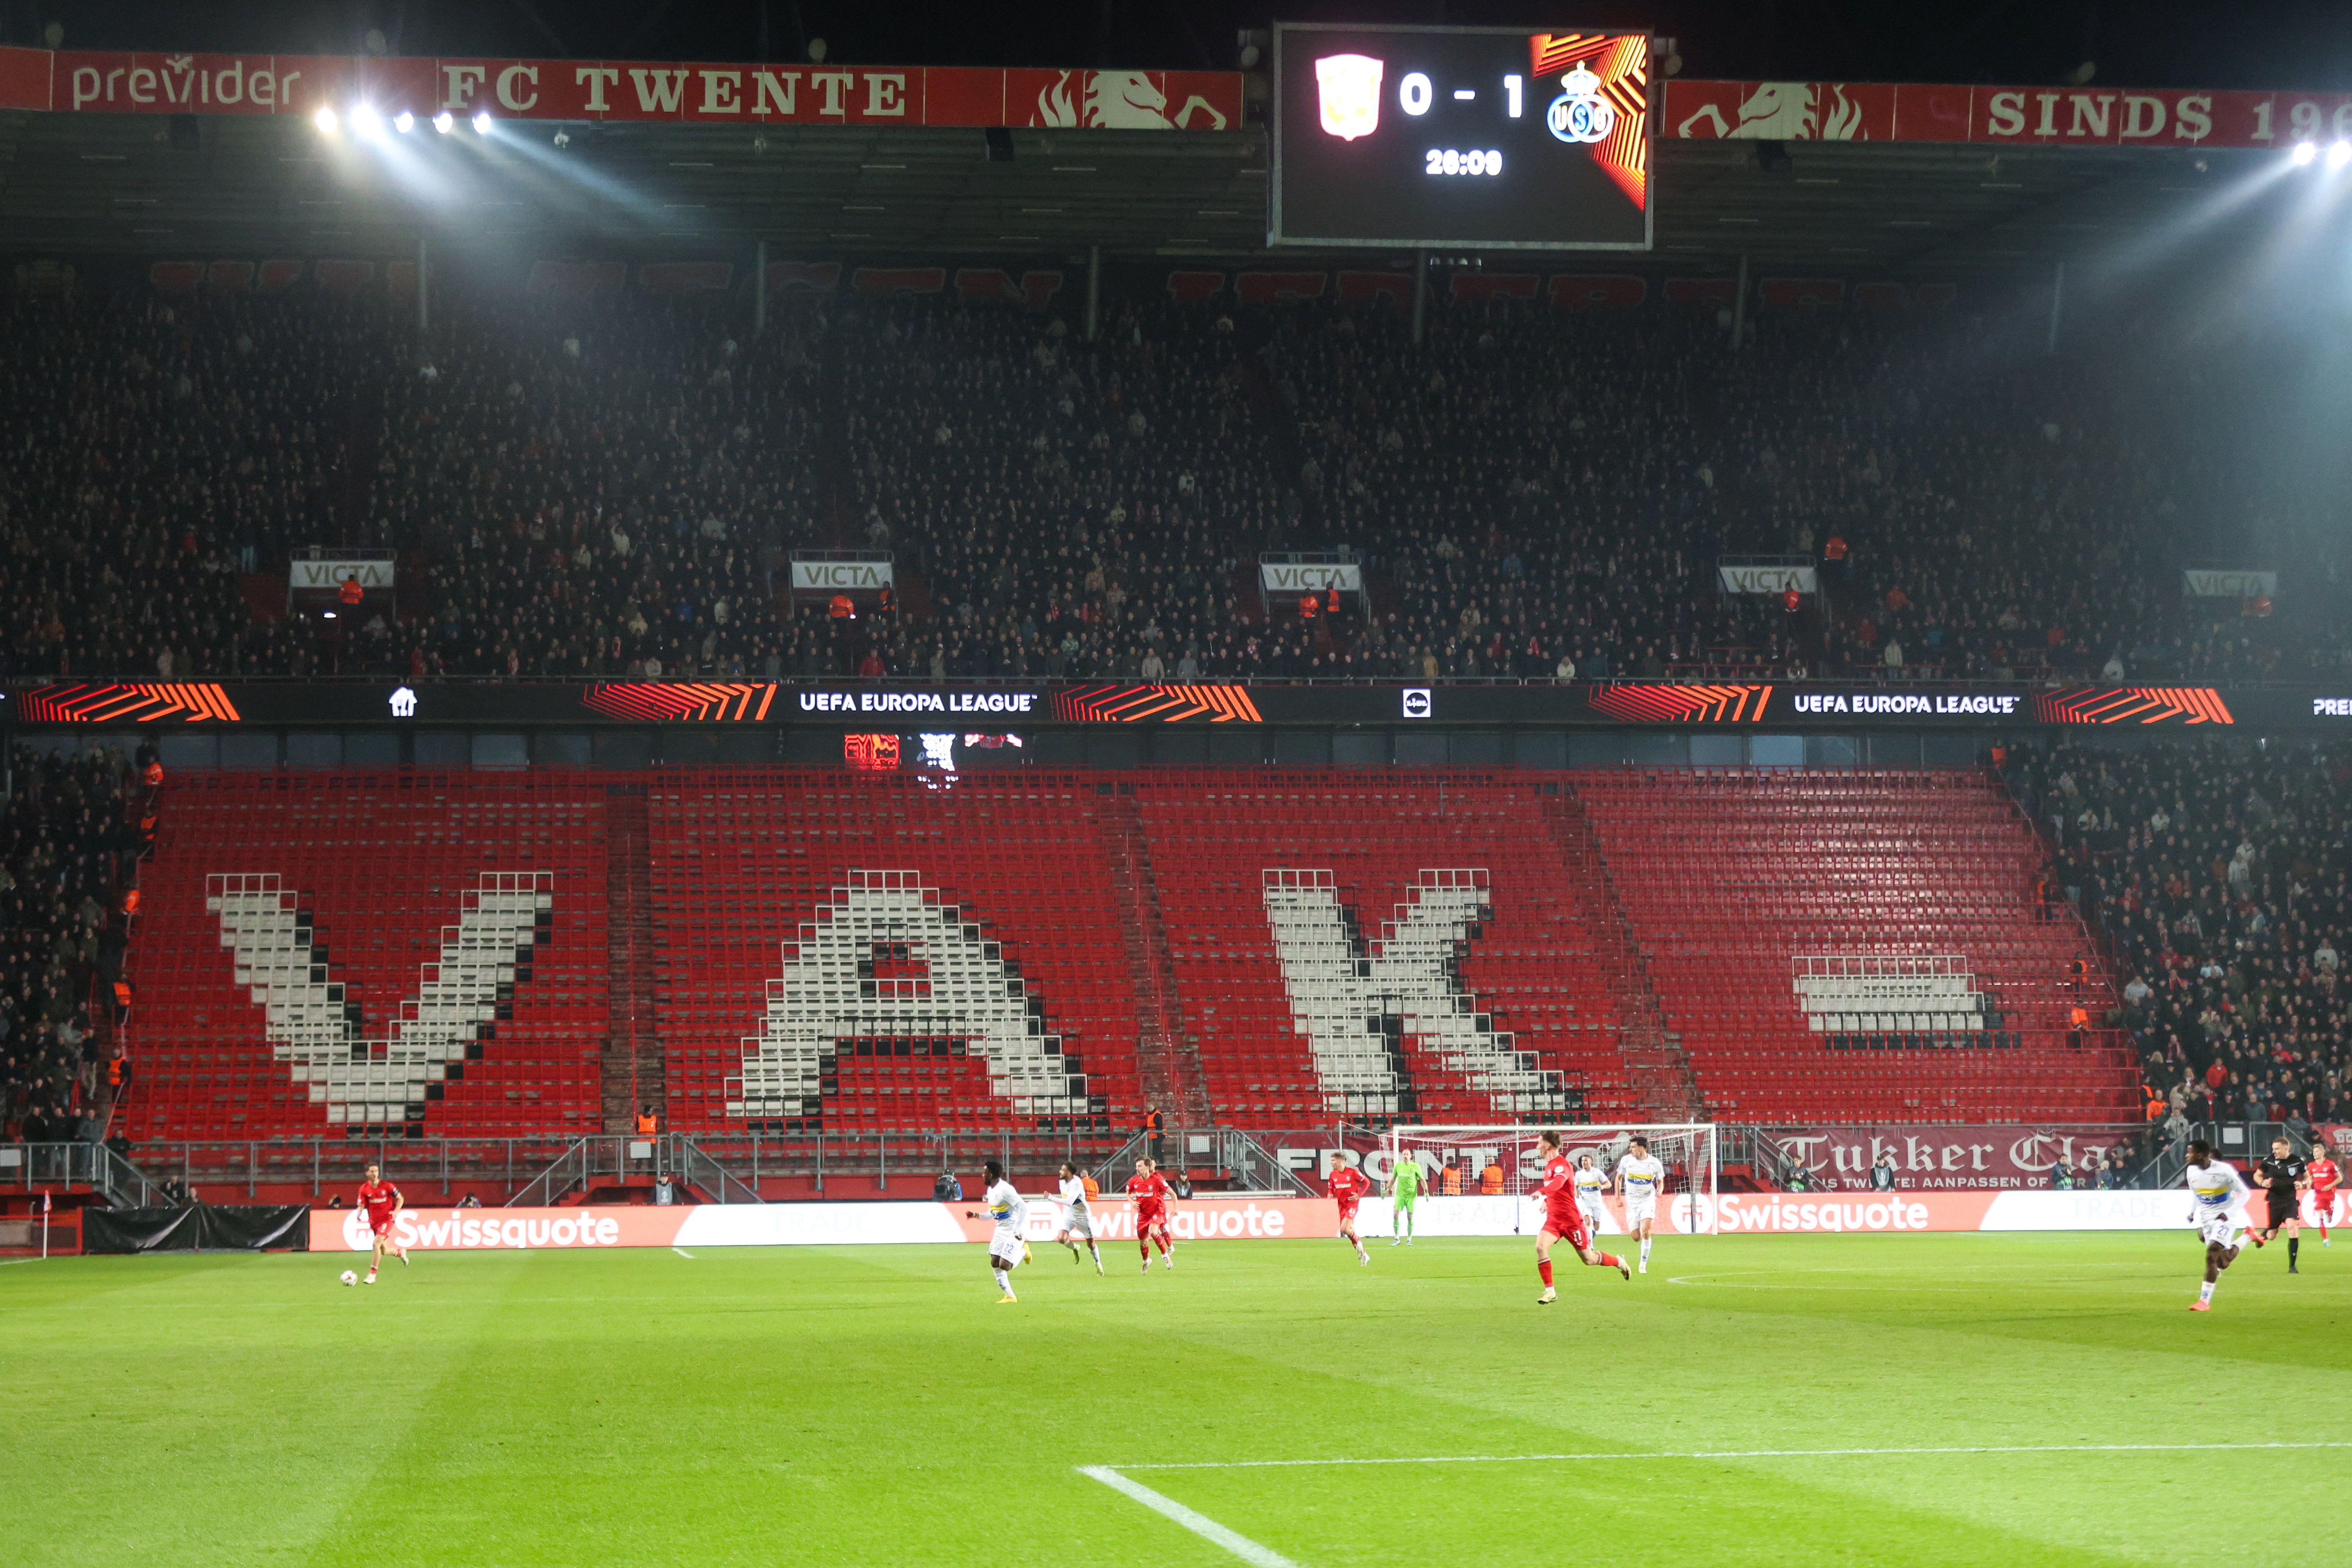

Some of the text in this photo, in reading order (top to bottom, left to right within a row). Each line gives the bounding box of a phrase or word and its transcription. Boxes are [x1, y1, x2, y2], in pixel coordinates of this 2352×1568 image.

[73, 60, 301, 111] previder
[442, 65, 905, 116] FC TWENTE
[1399, 72, 1433, 116] 0
[1504, 74, 1523, 118] 1
[1988, 92, 2212, 139] SINDS
[304, 564, 381, 584] VICTA
[804, 566, 878, 585] VICTA
[1273, 568, 1347, 587] VICTA
[1731, 571, 1804, 589] VICTA
[800, 693, 857, 712] UEFA
[861, 693, 945, 712] EUROPA
[1794, 695, 1848, 713] UEFA
[1852, 695, 1932, 713] EUROPA
[1277, 1148, 1498, 1181] FRONT
[1776, 1134, 1995, 1173] Tukker
[1922, 1177, 2020, 1188] AANPASSEN
[2027, 1177, 2049, 1187] OF
[1431, 1202, 1528, 1225] TRADE
[1718, 1195, 1929, 1231] Swissquote
[2069, 1197, 2164, 1219] TRADE
[395, 1209, 619, 1249] Swissquote
[770, 1210, 870, 1233] TRADE
[2218, 1225, 2229, 1236] 27
[1004, 1243, 1014, 1254] 22
